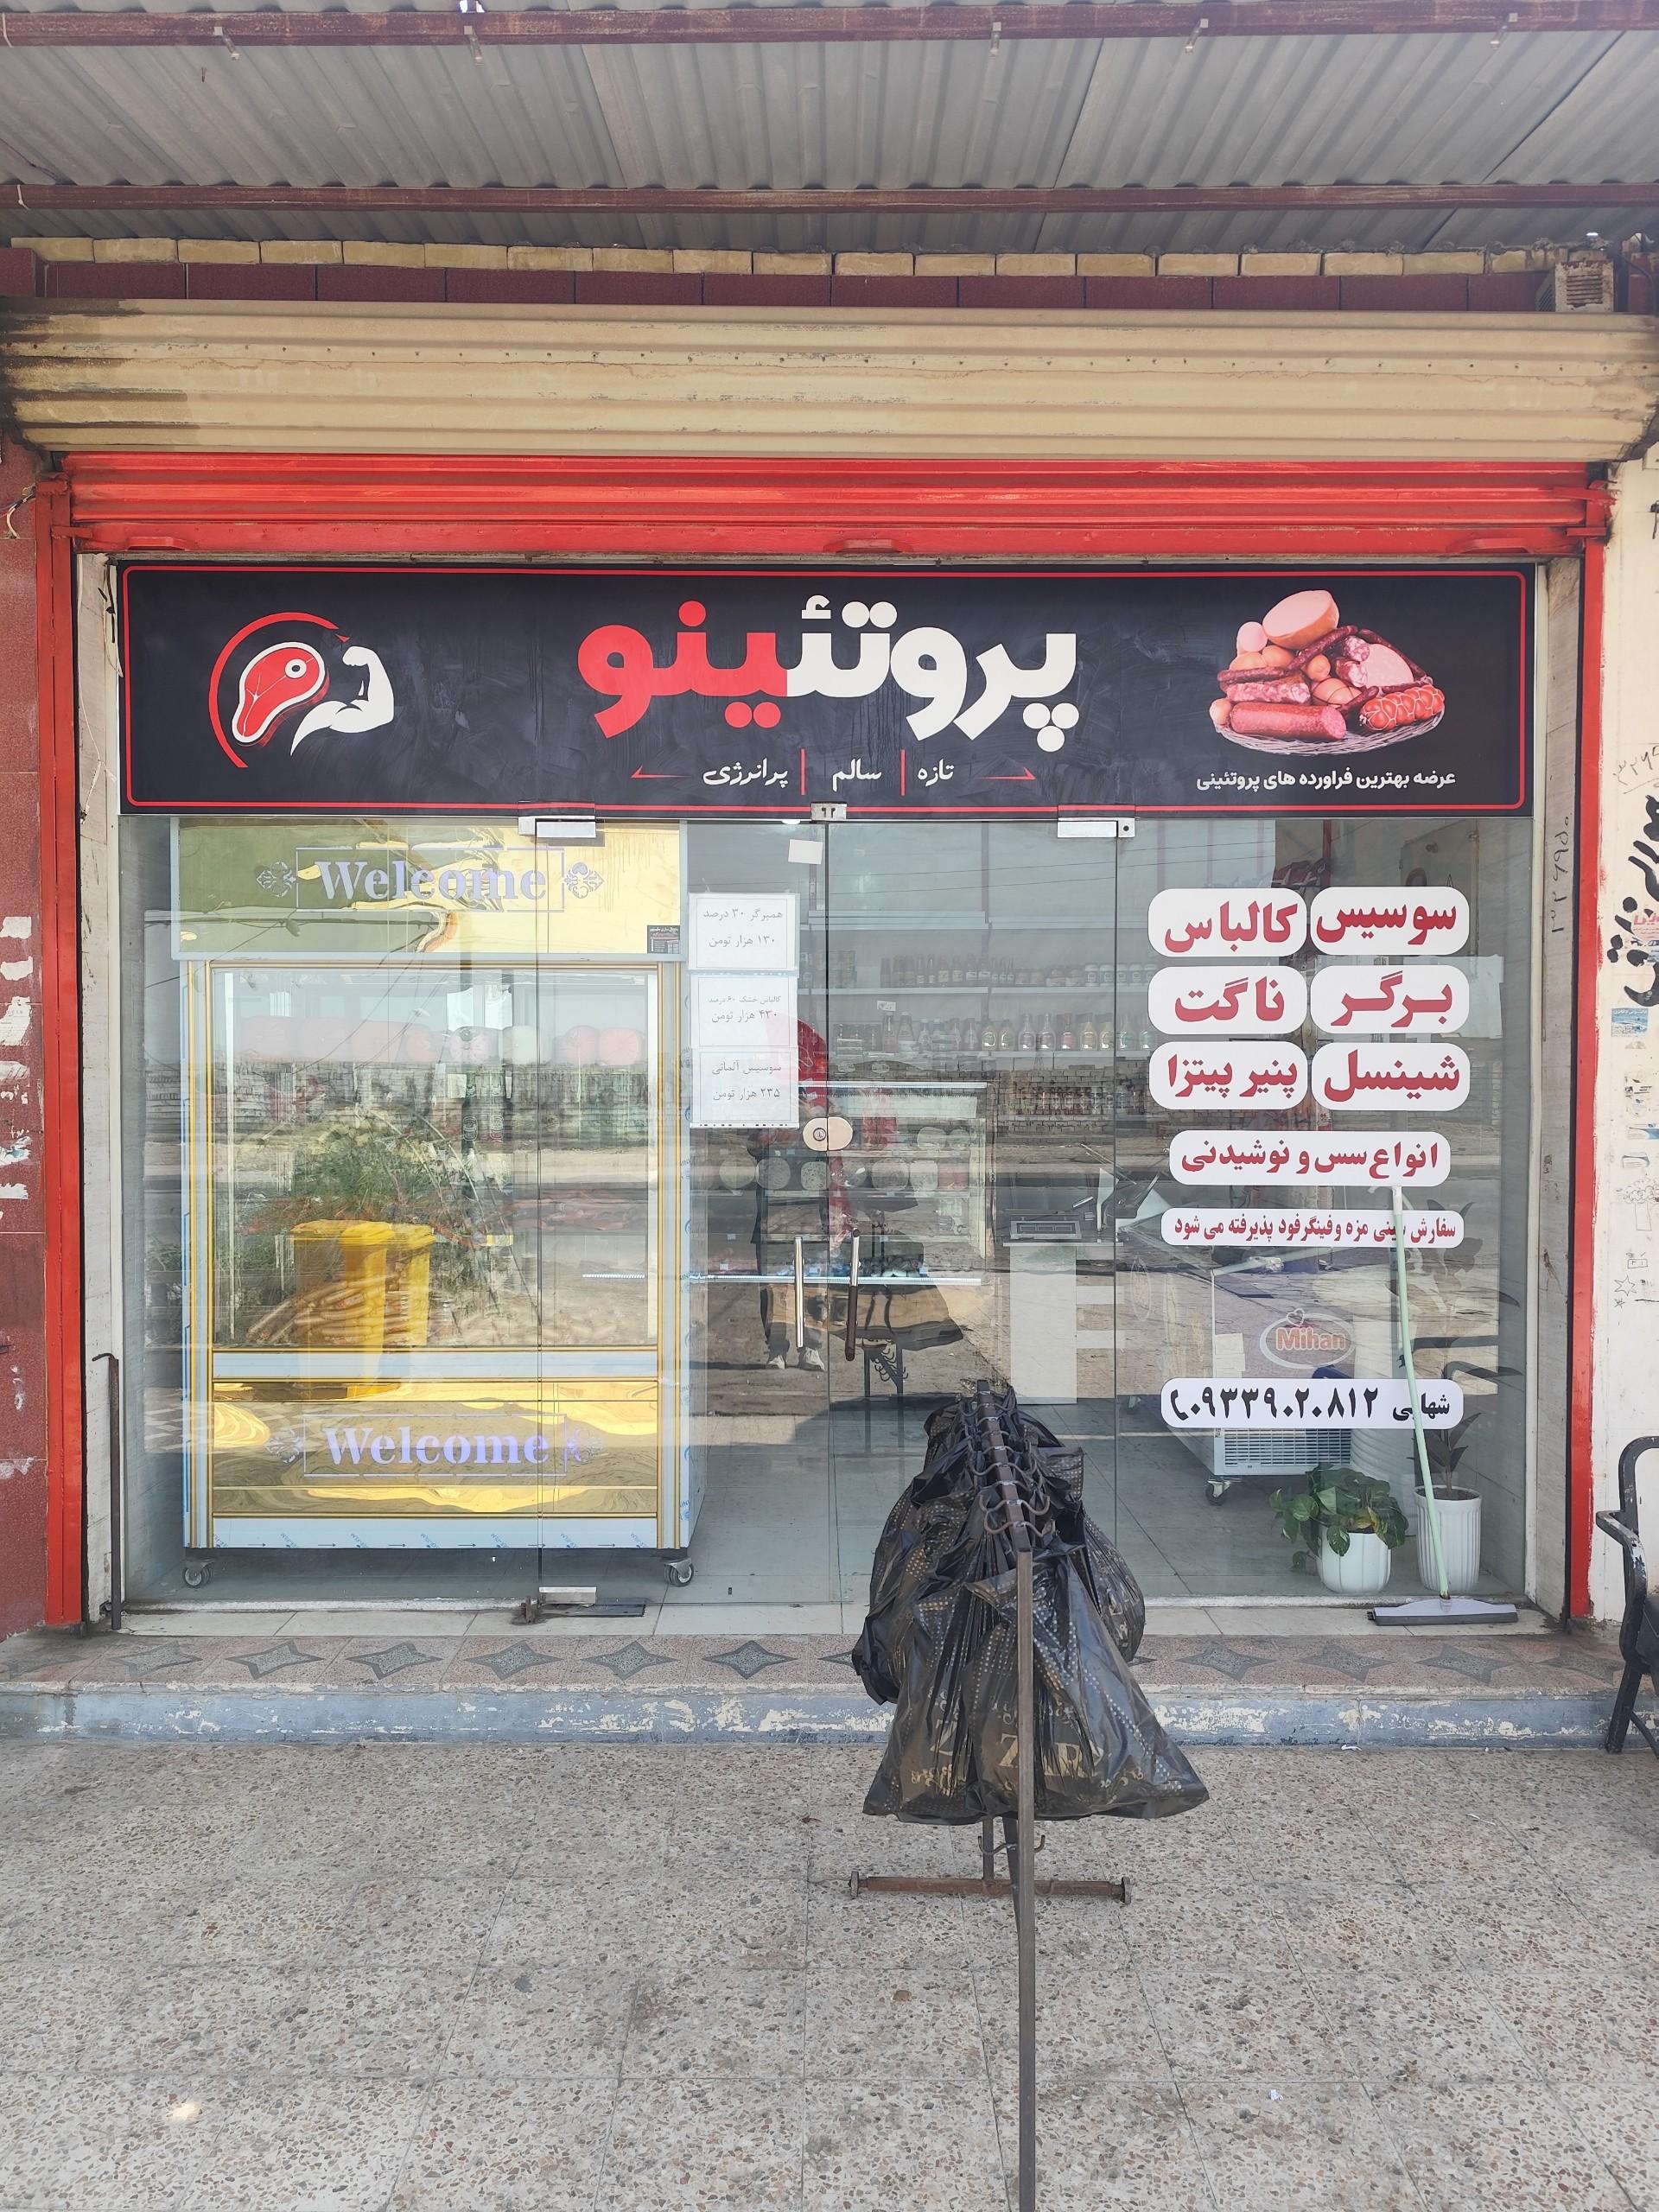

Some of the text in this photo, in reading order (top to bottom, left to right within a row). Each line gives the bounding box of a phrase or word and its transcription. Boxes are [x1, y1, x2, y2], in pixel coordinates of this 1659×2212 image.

[577, 594, 1080, 753] پروتئینو
[702, 757, 789, 789] پرانرژی
[832, 758, 882, 791] سالم
[917, 758, 955, 787] تازه
[1196, 766, 1457, 792] عرضه بهترین فراورده های پروتئینی
[314, 860, 546, 900] Welcome
[703, 908, 783, 921] همبرگر ۳۰ درصد
[1164, 899, 1298, 953] کالباس
[1316, 904, 1457, 945] سوسیس
[709, 934, 775, 948] ۱۳۰ هزار تومن
[1174, 976, 1285, 1023] ناگت
[1331, 970, 1453, 1027] برگر
[711, 1009, 777, 1023] ۴۳۰ هزار تومن
[711, 1059, 782, 1075] سوسیس آلمانی
[1167, 1053, 1298, 1099] پنیر پیتزا
[1324, 1049, 1460, 1103] شینسل
[713, 1088, 780, 1101] ۲۳۵ هزار تومن
[1181, 1139, 1439, 1179] انواع سس و نوشیدنی
[1174, 1215, 1200, 1240] شود
[1204, 1222, 1224, 1240] می
[1228, 1213, 1274, 1243] پذیرفته
[1345, 1219, 1369, 1242] مزه
[1373, 1220, 1406, 1243] ینی
[1410, 1217, 1456, 1244] سفارش
[1275, 1326, 1347, 1351] Mihan
[1190, 1386, 1451, 1421] شهای ۰۹۳۳۹۰۲۰۸۱۲
[321, 1426, 550, 1465] Welcome
